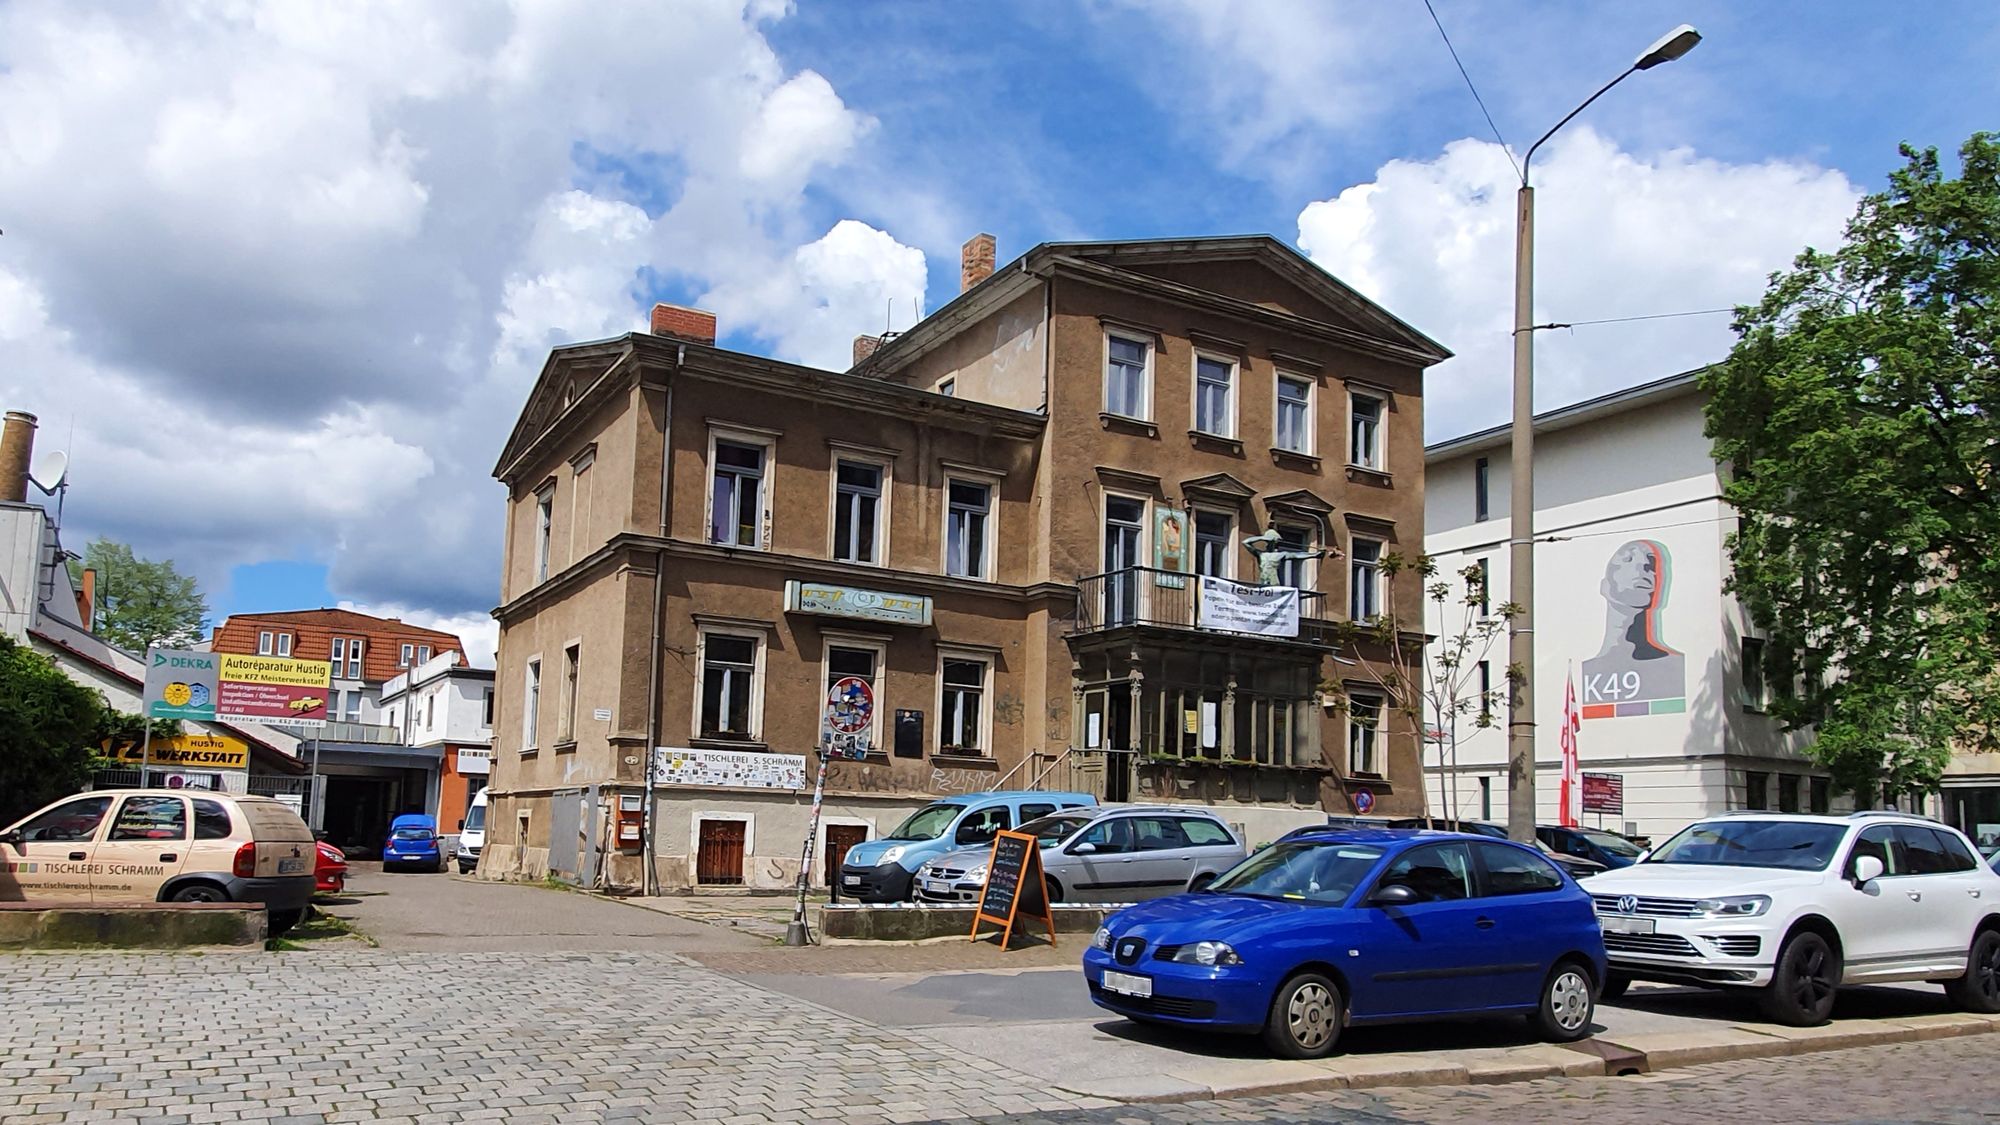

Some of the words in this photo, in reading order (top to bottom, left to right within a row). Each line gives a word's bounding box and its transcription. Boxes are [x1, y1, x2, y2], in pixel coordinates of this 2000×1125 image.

[170, 657, 213, 670] DEKRA
[225, 657, 293, 673] Autoreparatur
[296, 664, 326, 677] Hustig
[224, 671, 242, 680] freie
[261, 674, 325, 685] Meisterwerkstatt
[1584, 671, 1641, 702] K49
[220, 715, 257, 723] Reparatur
[190, 739, 224, 748] HUSTIG
[704, 754, 749, 763] TISCHLEREI
[762, 758, 803, 767] SCHRAMM
[45, 863, 103, 875] TISCHLEREI
[108, 864, 164, 876] SCHRAMM
[18, 882, 132, 891] www.tischlereischramm.de
